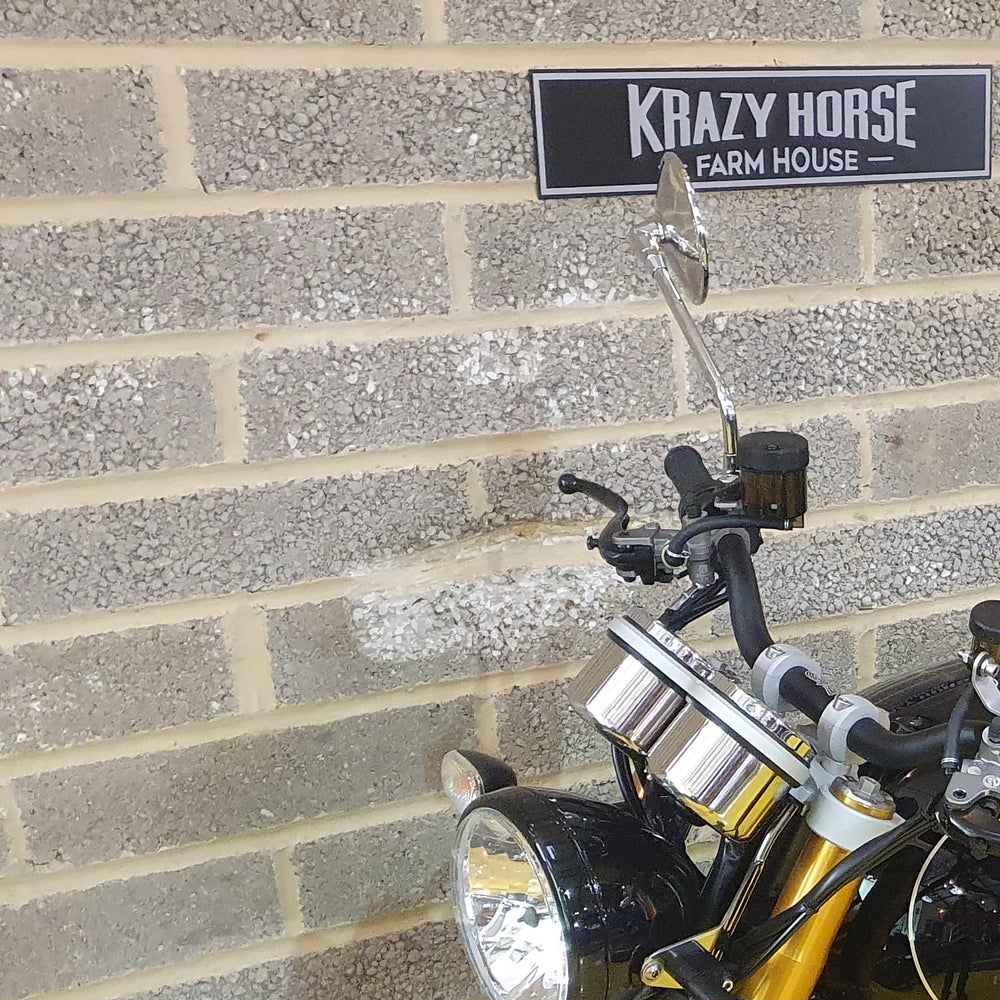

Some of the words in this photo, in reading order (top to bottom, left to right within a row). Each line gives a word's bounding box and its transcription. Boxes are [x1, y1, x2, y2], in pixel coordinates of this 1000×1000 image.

[627, 83, 777, 159] KRAZY
[788, 79, 916, 148] HORSE
[696, 148, 765, 177] FARM
[773, 146, 859, 174] HOUSE
